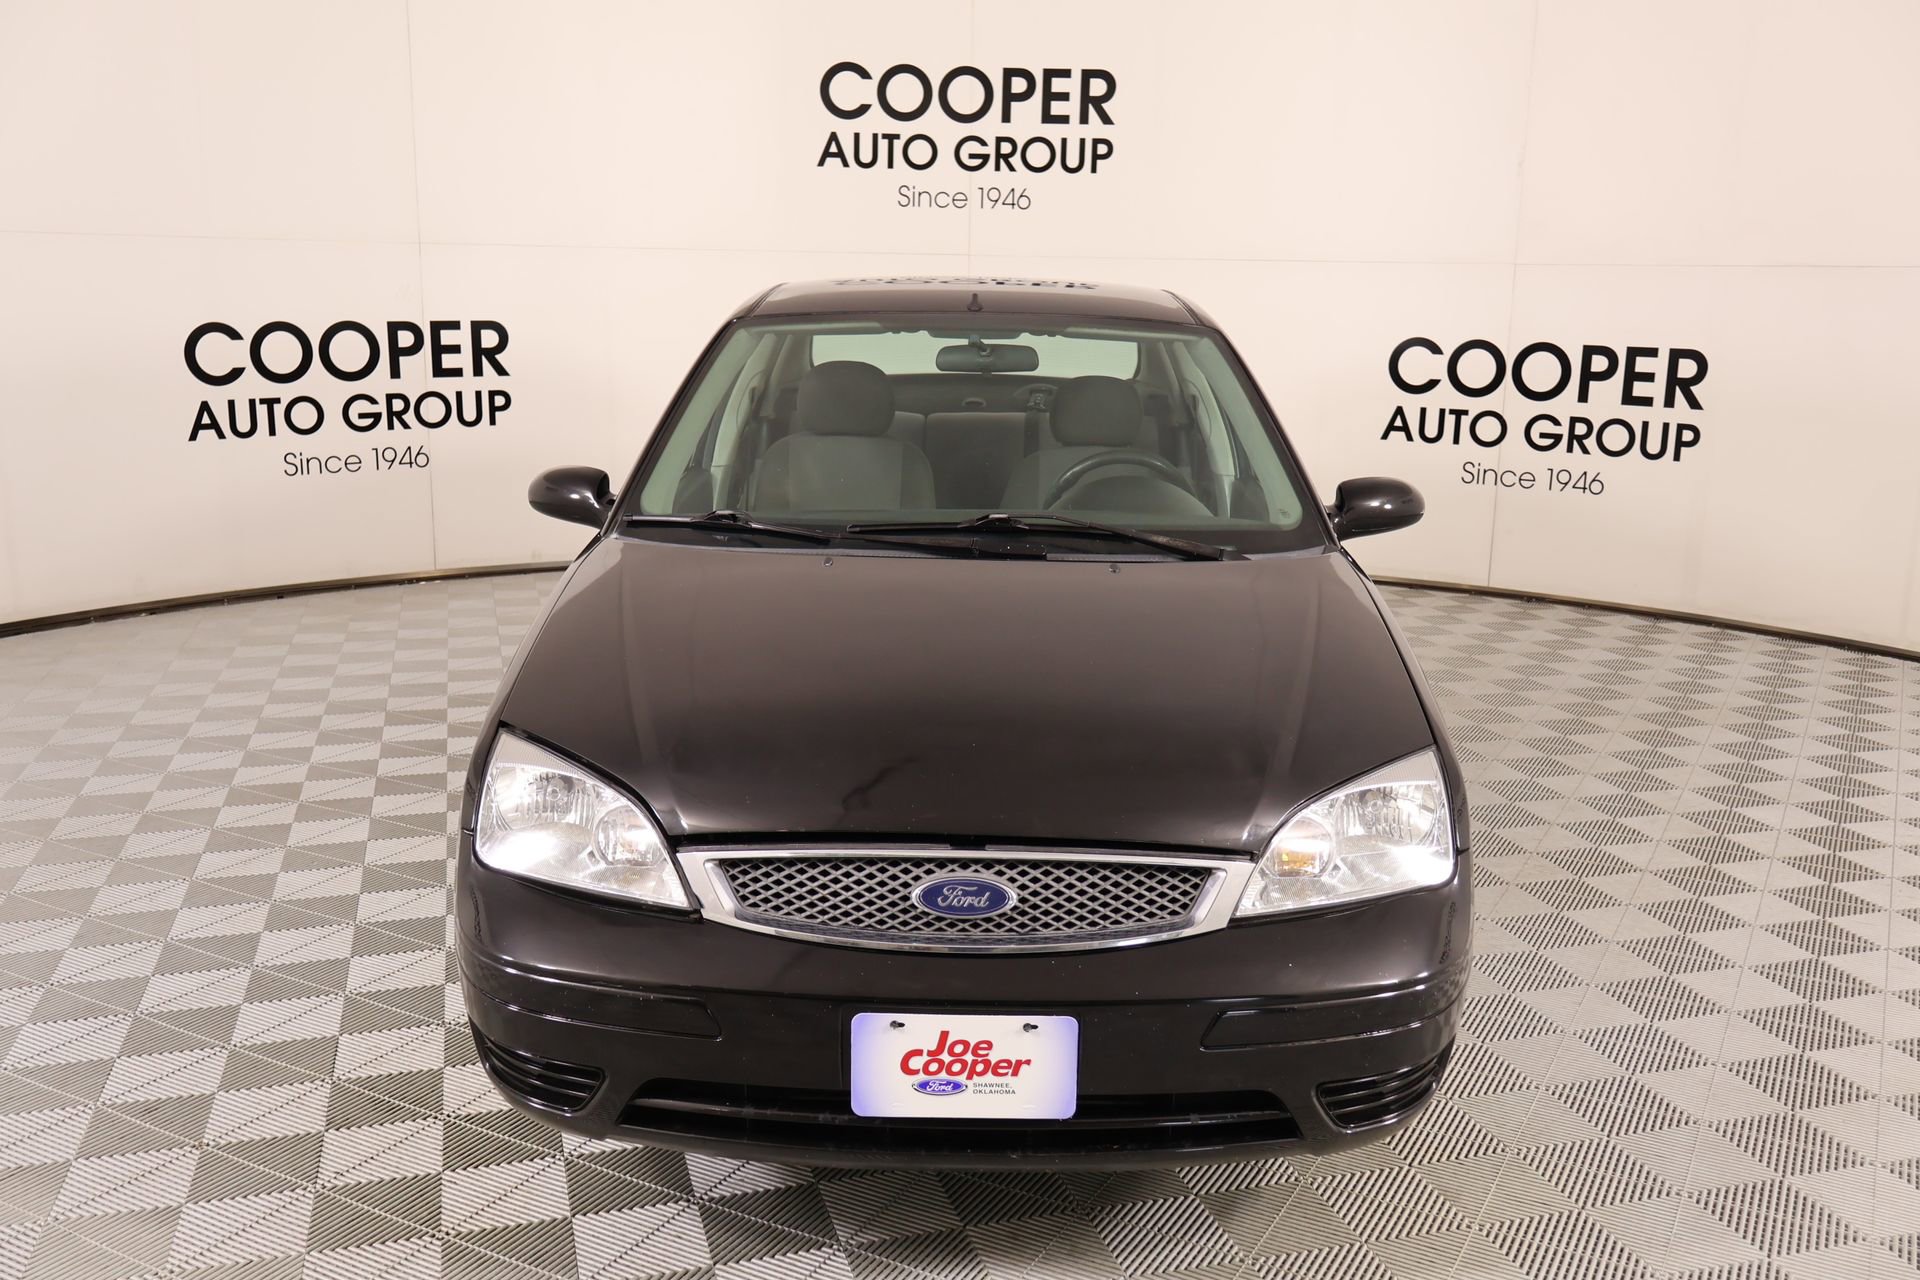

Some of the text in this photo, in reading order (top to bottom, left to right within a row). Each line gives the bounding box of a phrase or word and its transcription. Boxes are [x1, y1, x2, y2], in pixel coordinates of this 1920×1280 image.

[820, 62, 1117, 126] COOPER
[817, 131, 1114, 175] AUTO GROUP
[897, 184, 1031, 210] Since 1946
[184, 320, 511, 387] COOPER
[1388, 337, 1709, 411] COOPER
[188, 389, 512, 442] AUTO GROUP
[1381, 405, 1702, 463] AUTO GROUP
[283, 444, 430, 477] Since 1946
[1461, 461, 1605, 496] Since 1946
[937, 884, 991, 908] Ford
[926, 1030, 993, 1058] Joe
[899, 1048, 1032, 1081] Cooper
[926, 1080, 954, 1091] Ford
